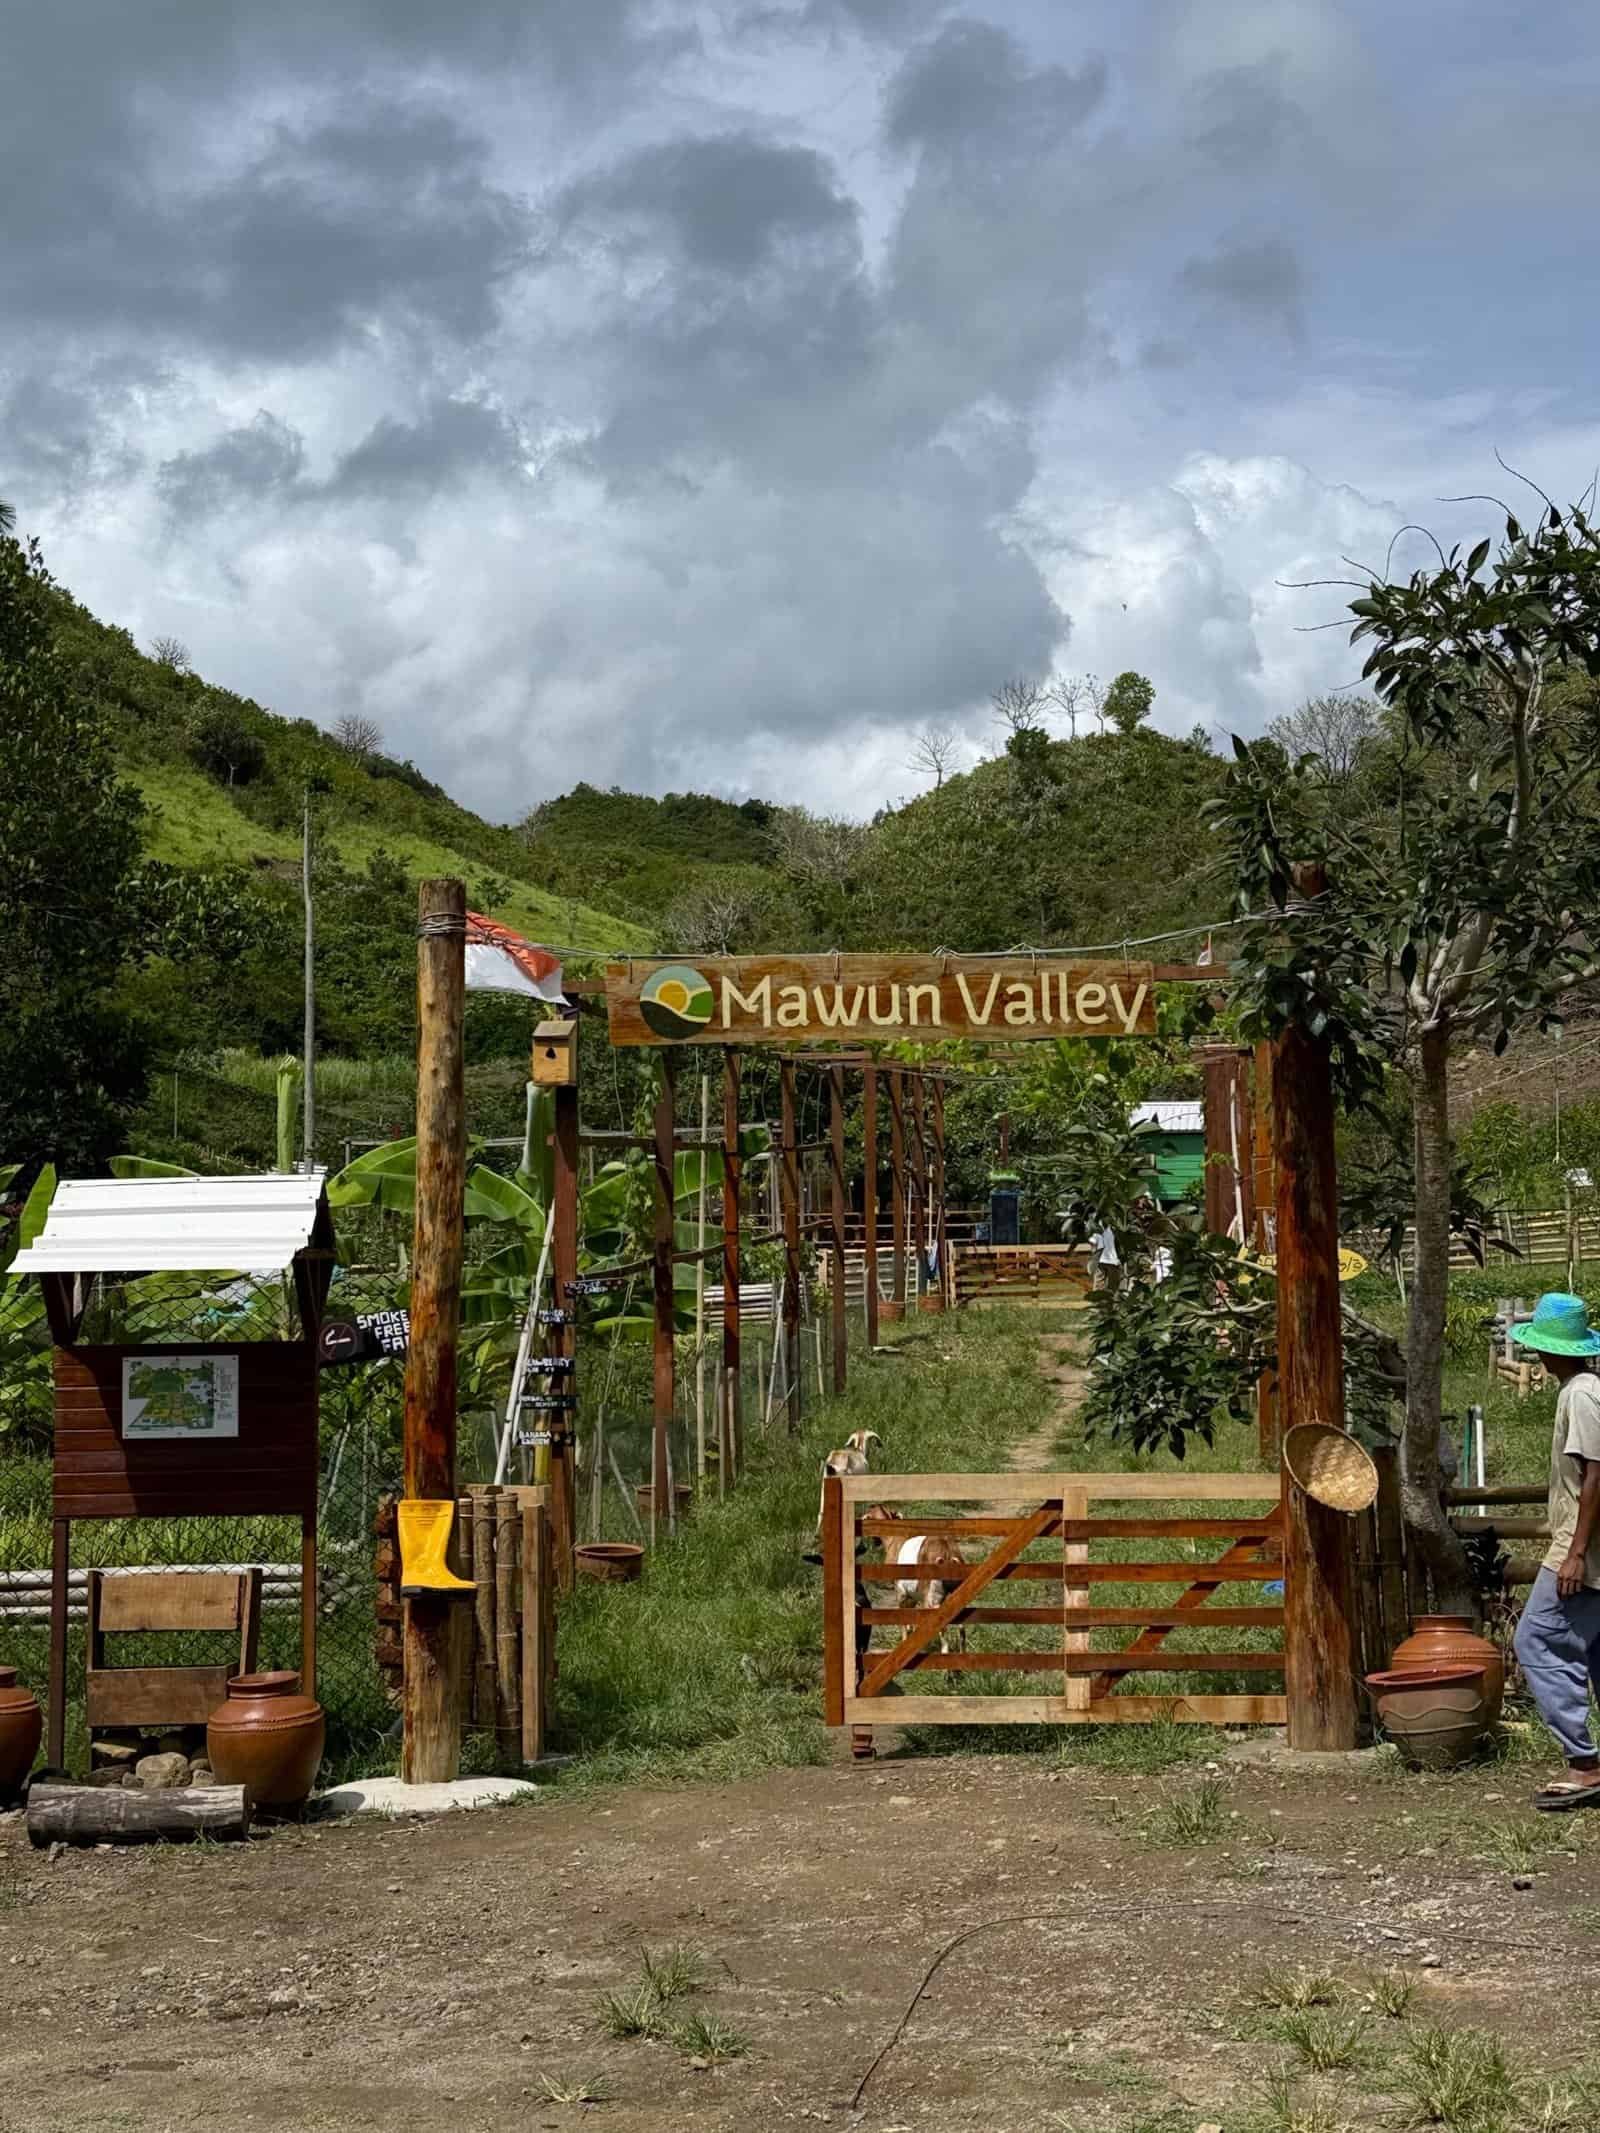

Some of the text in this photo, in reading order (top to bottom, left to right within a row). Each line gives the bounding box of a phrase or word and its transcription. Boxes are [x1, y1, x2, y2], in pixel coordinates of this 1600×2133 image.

[722, 972, 1148, 1033] Mawun Valley
[356, 1309, 409, 1329] SMOKE
[374, 1321, 411, 1339] FREE
[381, 1335, 410, 1352] FA
